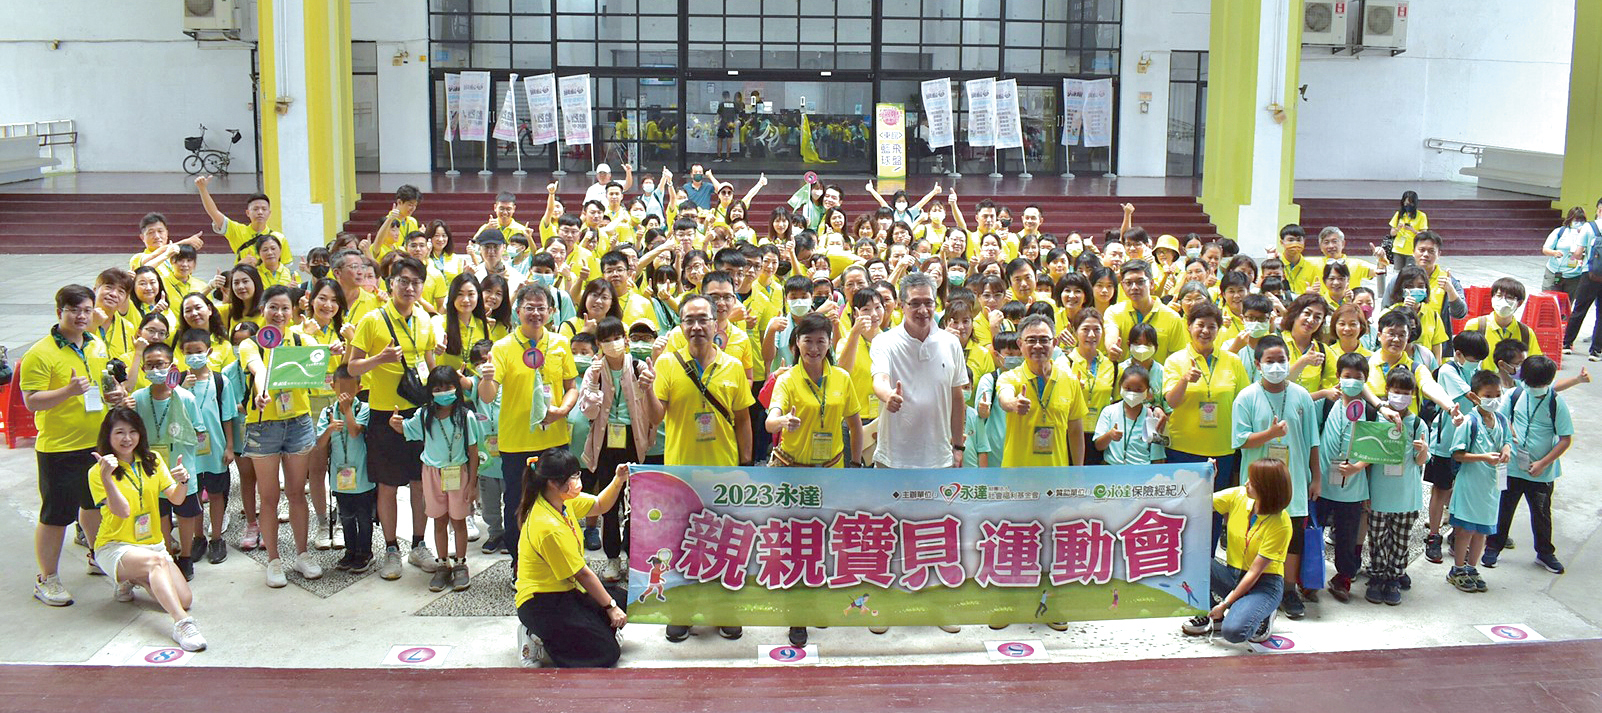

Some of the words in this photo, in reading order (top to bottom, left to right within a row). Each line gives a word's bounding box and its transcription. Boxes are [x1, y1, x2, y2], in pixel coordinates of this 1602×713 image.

[263, 329, 275, 347] 9
[527, 351, 536, 367] 7
[169, 371, 179, 385] 10
[1352, 404, 1358, 418] 1
[713, 482, 821, 507] 2023永達
[959, 485, 988, 500] 永達
[988, 491, 1039, 499] 社會福利基金會
[676, 507, 1189, 591] 親親寶貝運動會
